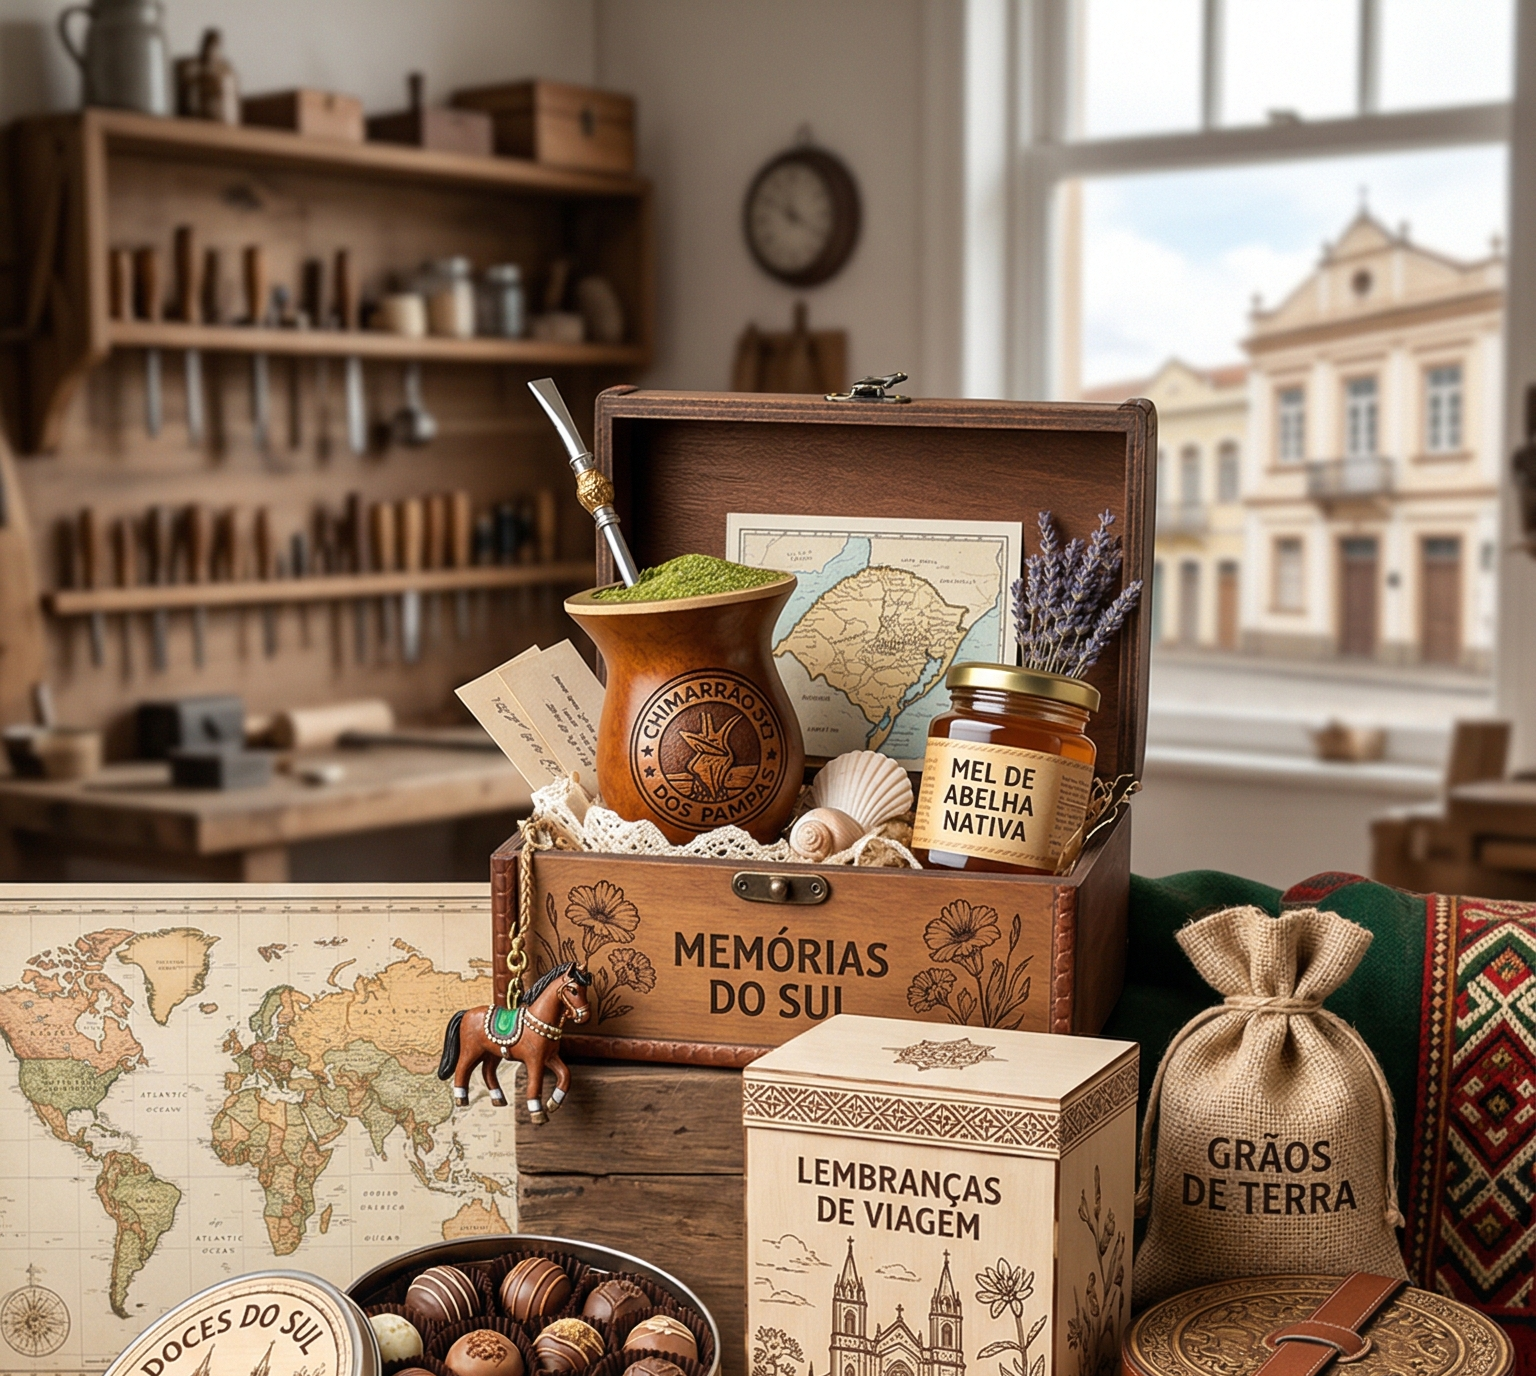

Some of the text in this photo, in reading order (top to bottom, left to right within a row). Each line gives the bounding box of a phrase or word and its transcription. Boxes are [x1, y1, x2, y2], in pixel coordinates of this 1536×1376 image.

[653, 768, 775, 822] DOS PAMPAS
[951, 757, 1036, 790] MEL DE
[943, 784, 1034, 817] ABELHA
[943, 809, 1026, 842] NATIVA
[674, 926, 889, 978] MEMÓRIAS
[710, 979, 766, 1017] DO
[1208, 1133, 1332, 1173] GRÃOS
[798, 1156, 1002, 1208] LEMBRANÇAS
[1182, 1172, 1358, 1215] DE TERRA
[817, 1195, 980, 1241] DE VIAGEM
[239, 1304, 280, 1328] DO
[279, 1310, 324, 1356] SUL
